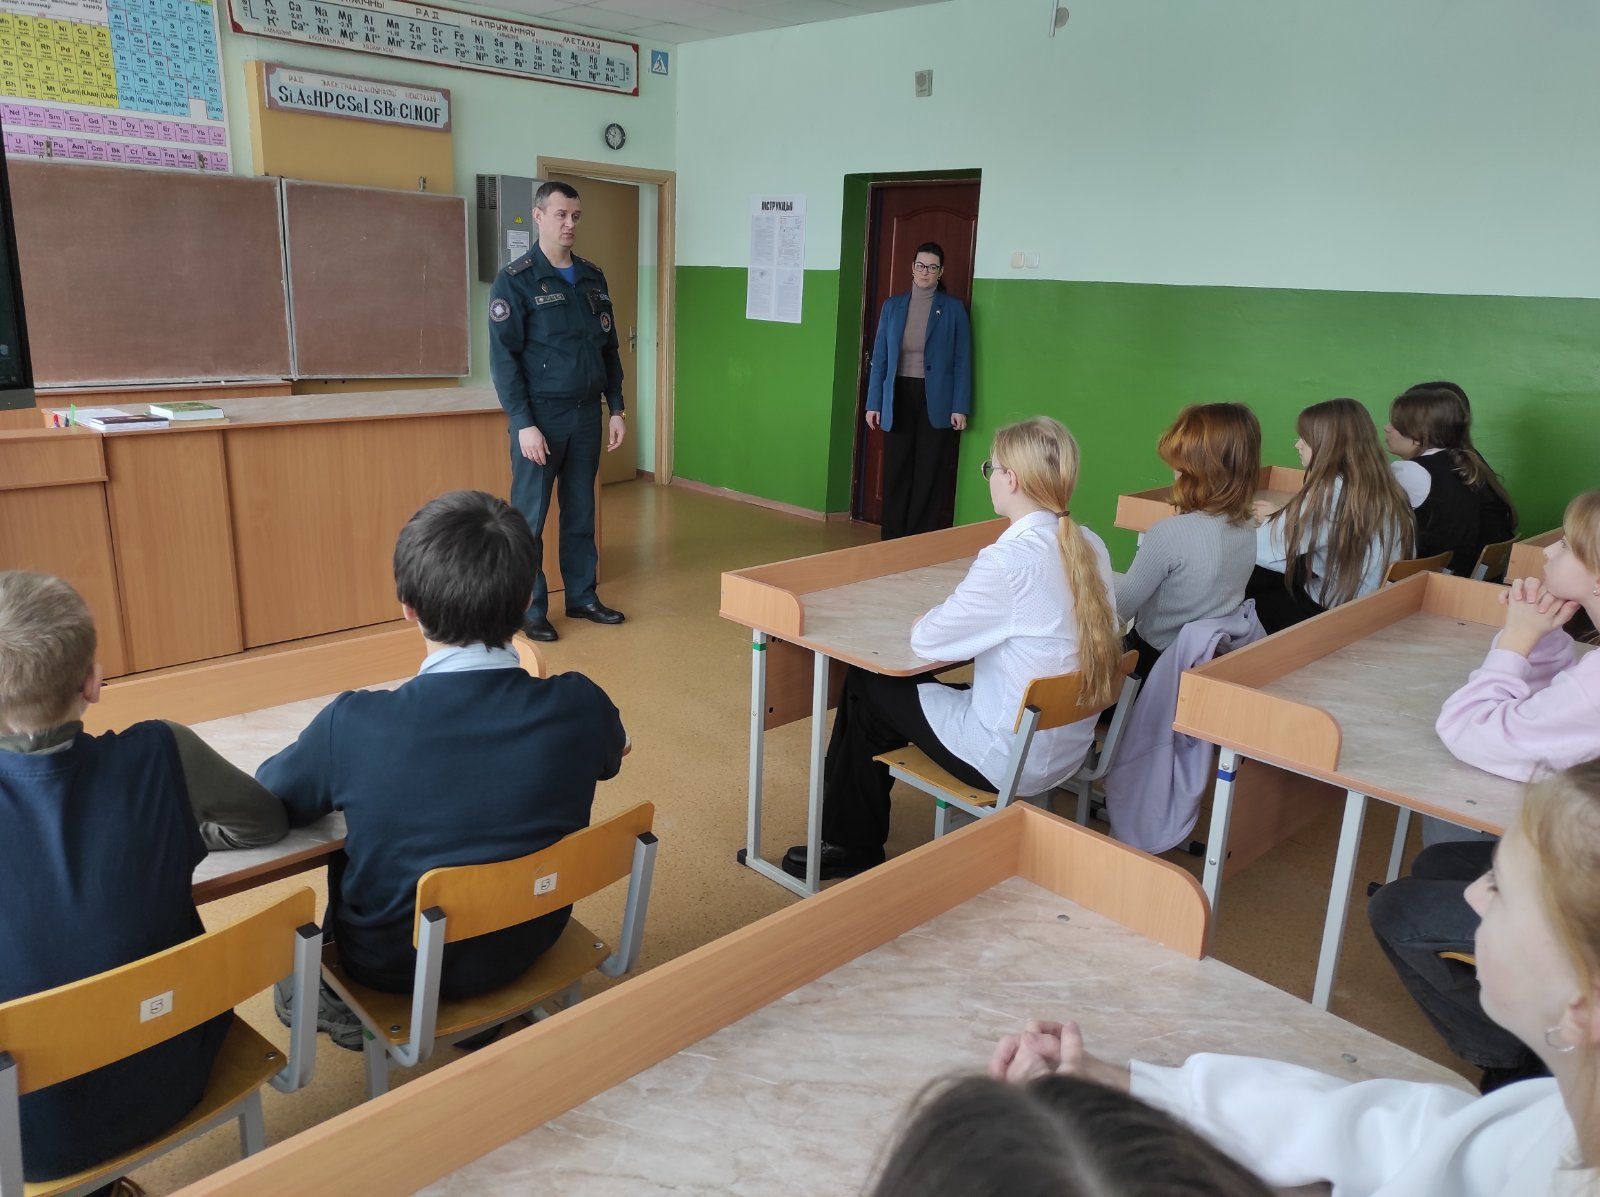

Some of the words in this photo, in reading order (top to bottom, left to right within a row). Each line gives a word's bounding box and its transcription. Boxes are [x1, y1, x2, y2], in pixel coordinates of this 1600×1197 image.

[288, 1, 302, 12] Ca
[314, 5, 328, 17] Na
[338, 10, 352, 22] Mg
[364, 15, 373, 25] Al
[386, 19, 400, 29] Mn
[409, 23, 421, 33] Zn
[432, 26, 443, 37] Cr
[454, 31, 464, 40] Fe
[475, 34, 484, 44] Ni
[494, 38, 504, 48] Sn
[514, 41, 523, 51] Pb
[552, 49, 562, 58] Cu
[571, 51, 578, 62] Ag
[590, 55, 598, 64] Hg
[606, 57, 615, 67] Au
[416, 8, 440, 21] РАД
